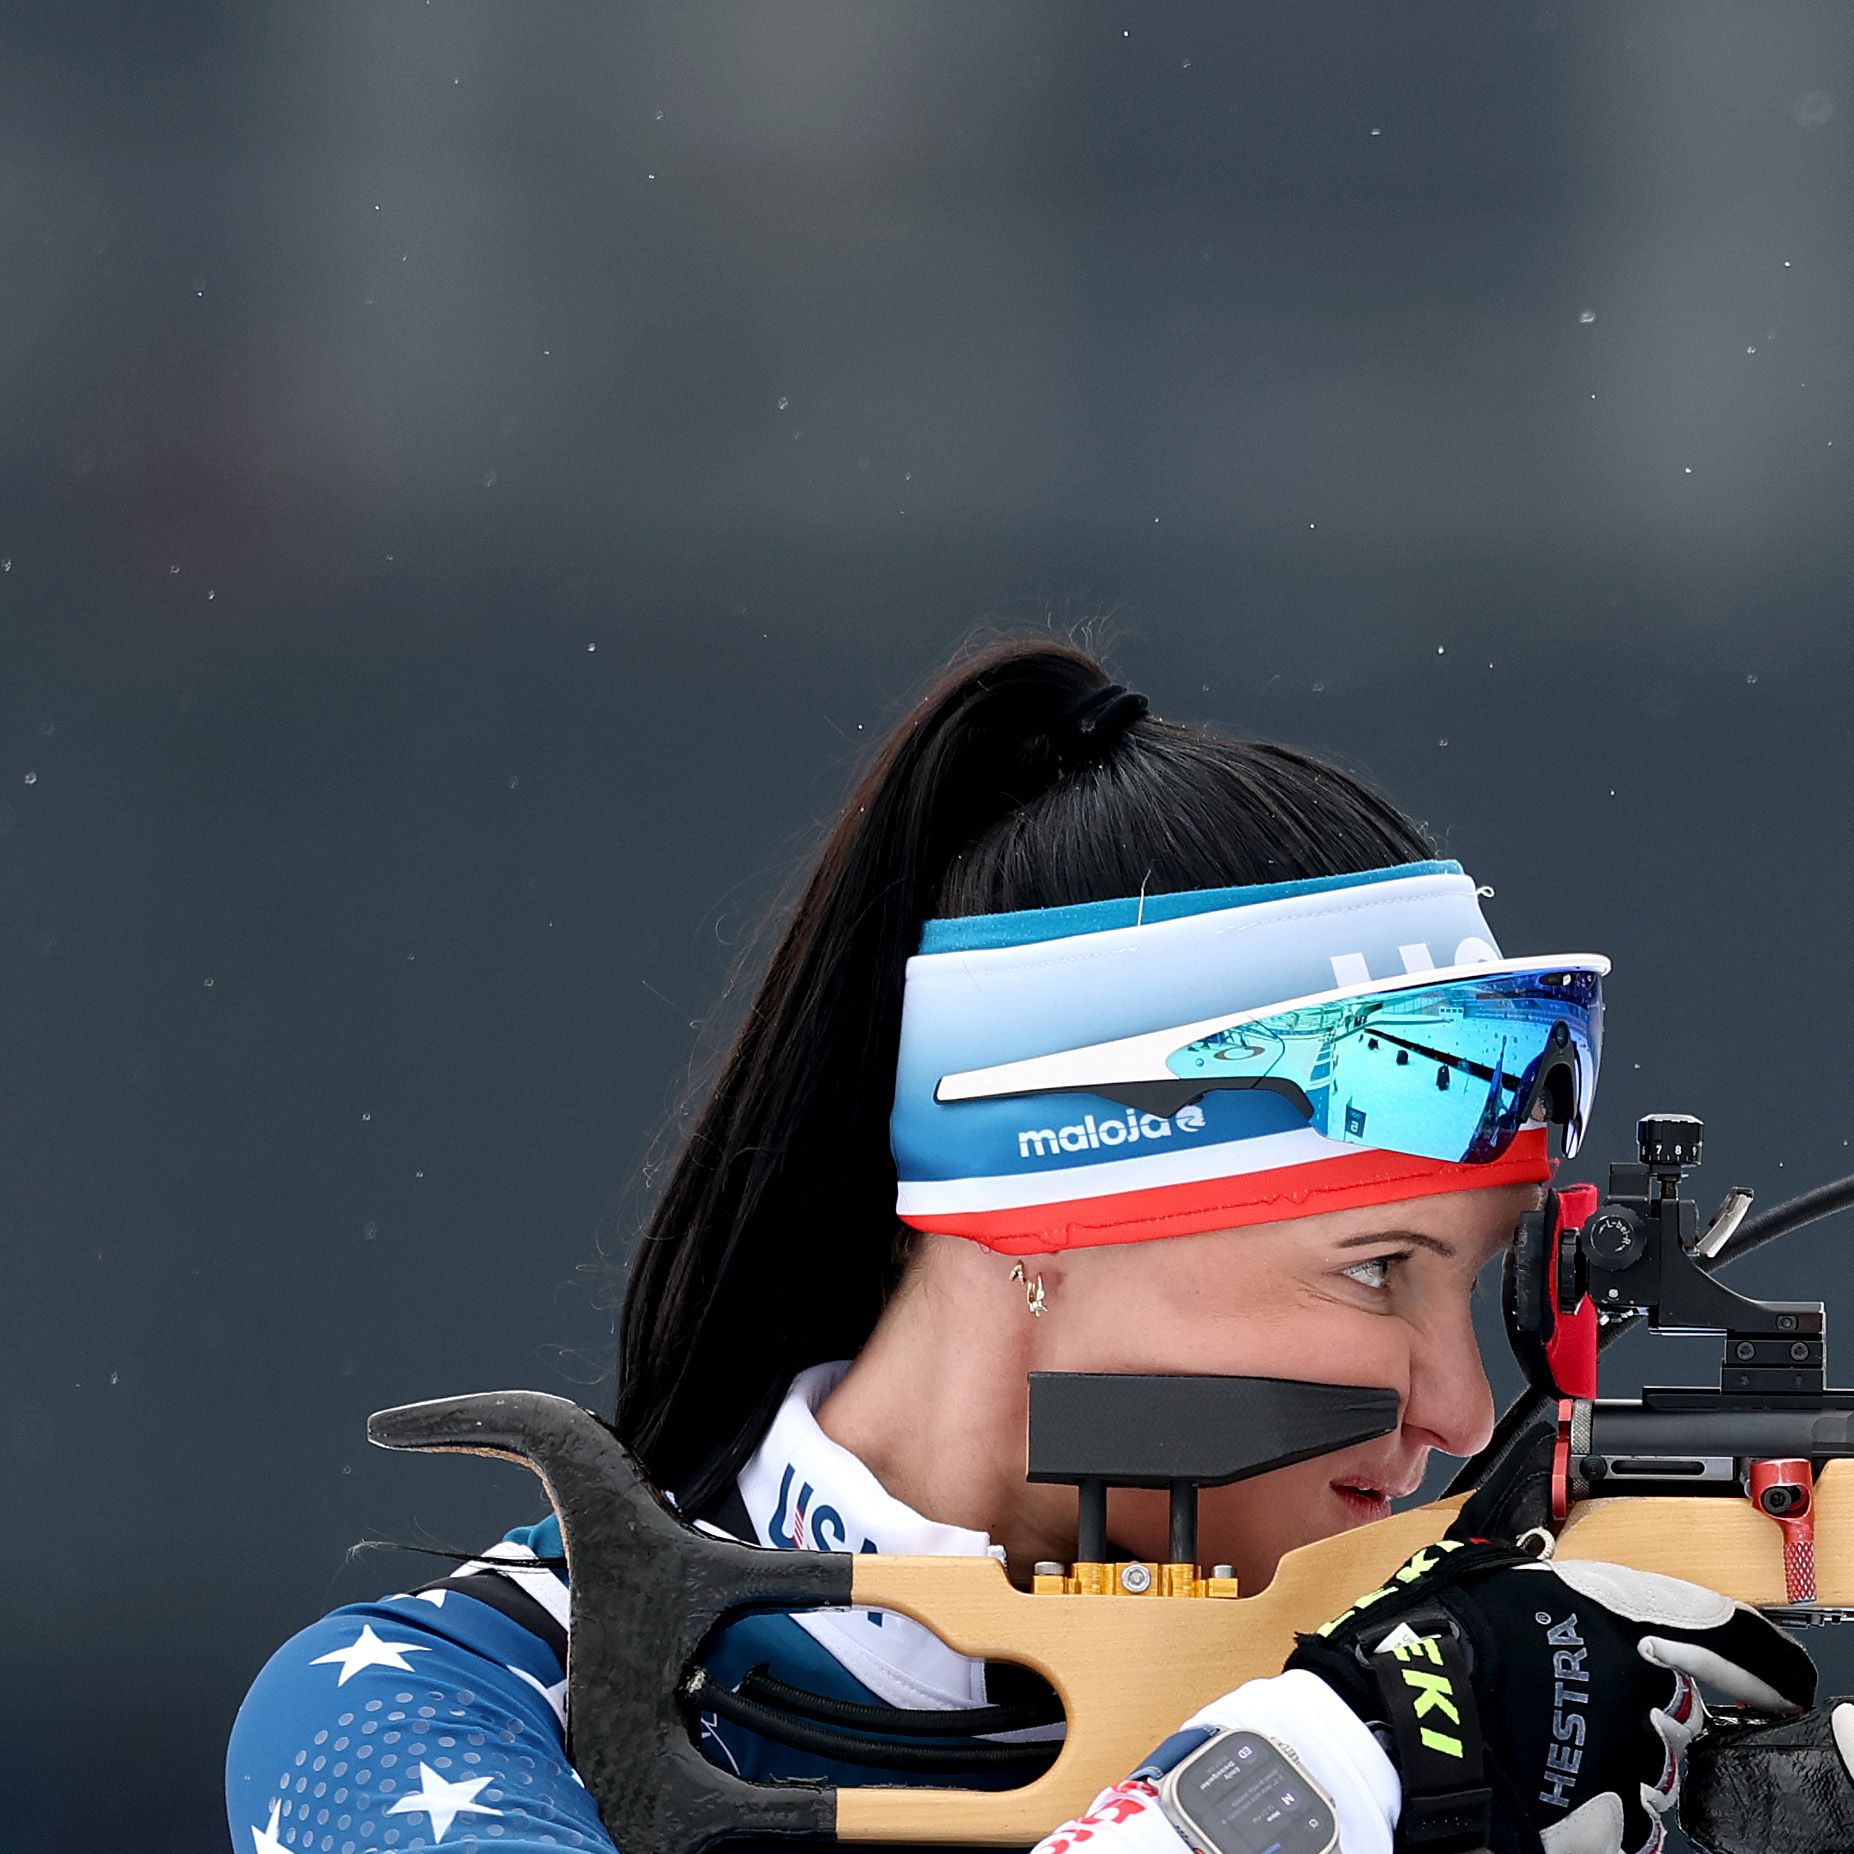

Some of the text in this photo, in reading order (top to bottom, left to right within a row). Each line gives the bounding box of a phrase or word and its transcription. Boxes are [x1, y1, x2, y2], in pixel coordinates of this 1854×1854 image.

[1018, 1108, 1172, 1158] maloja
[1655, 1144, 1662, 1155] 7
[1674, 1144, 1682, 1155] 8
[768, 1462, 883, 1628] US
